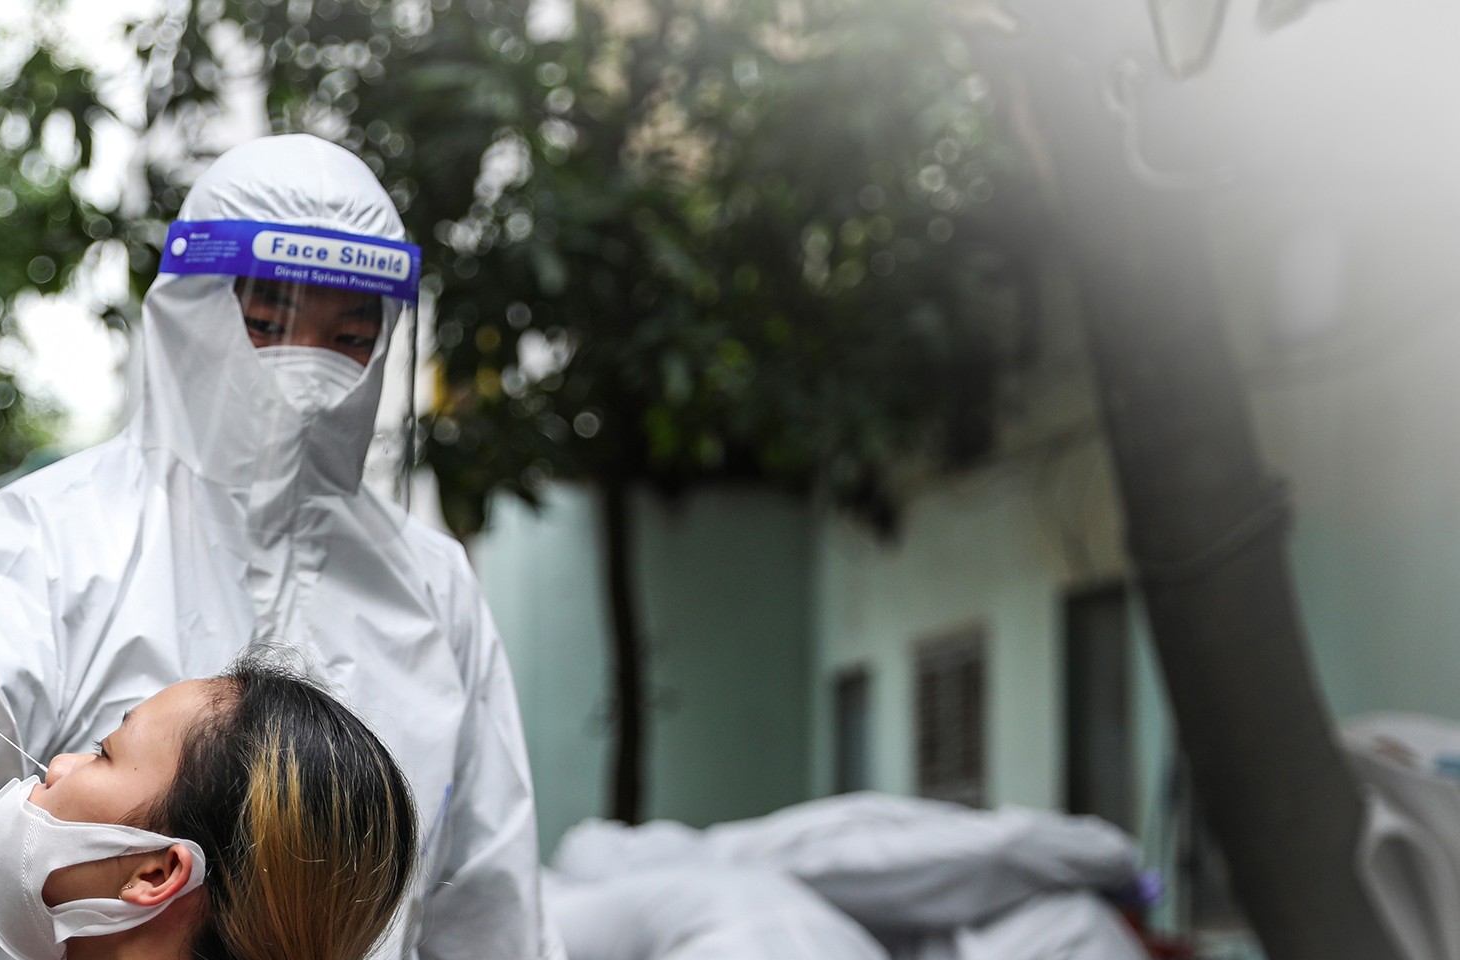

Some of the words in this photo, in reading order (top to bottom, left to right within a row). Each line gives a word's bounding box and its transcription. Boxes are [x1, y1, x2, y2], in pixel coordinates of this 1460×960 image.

[271, 237, 329, 261] Face
[340, 246, 403, 274] Shield
[274, 265, 309, 280] Direct
[311, 270, 348, 285] Splash
